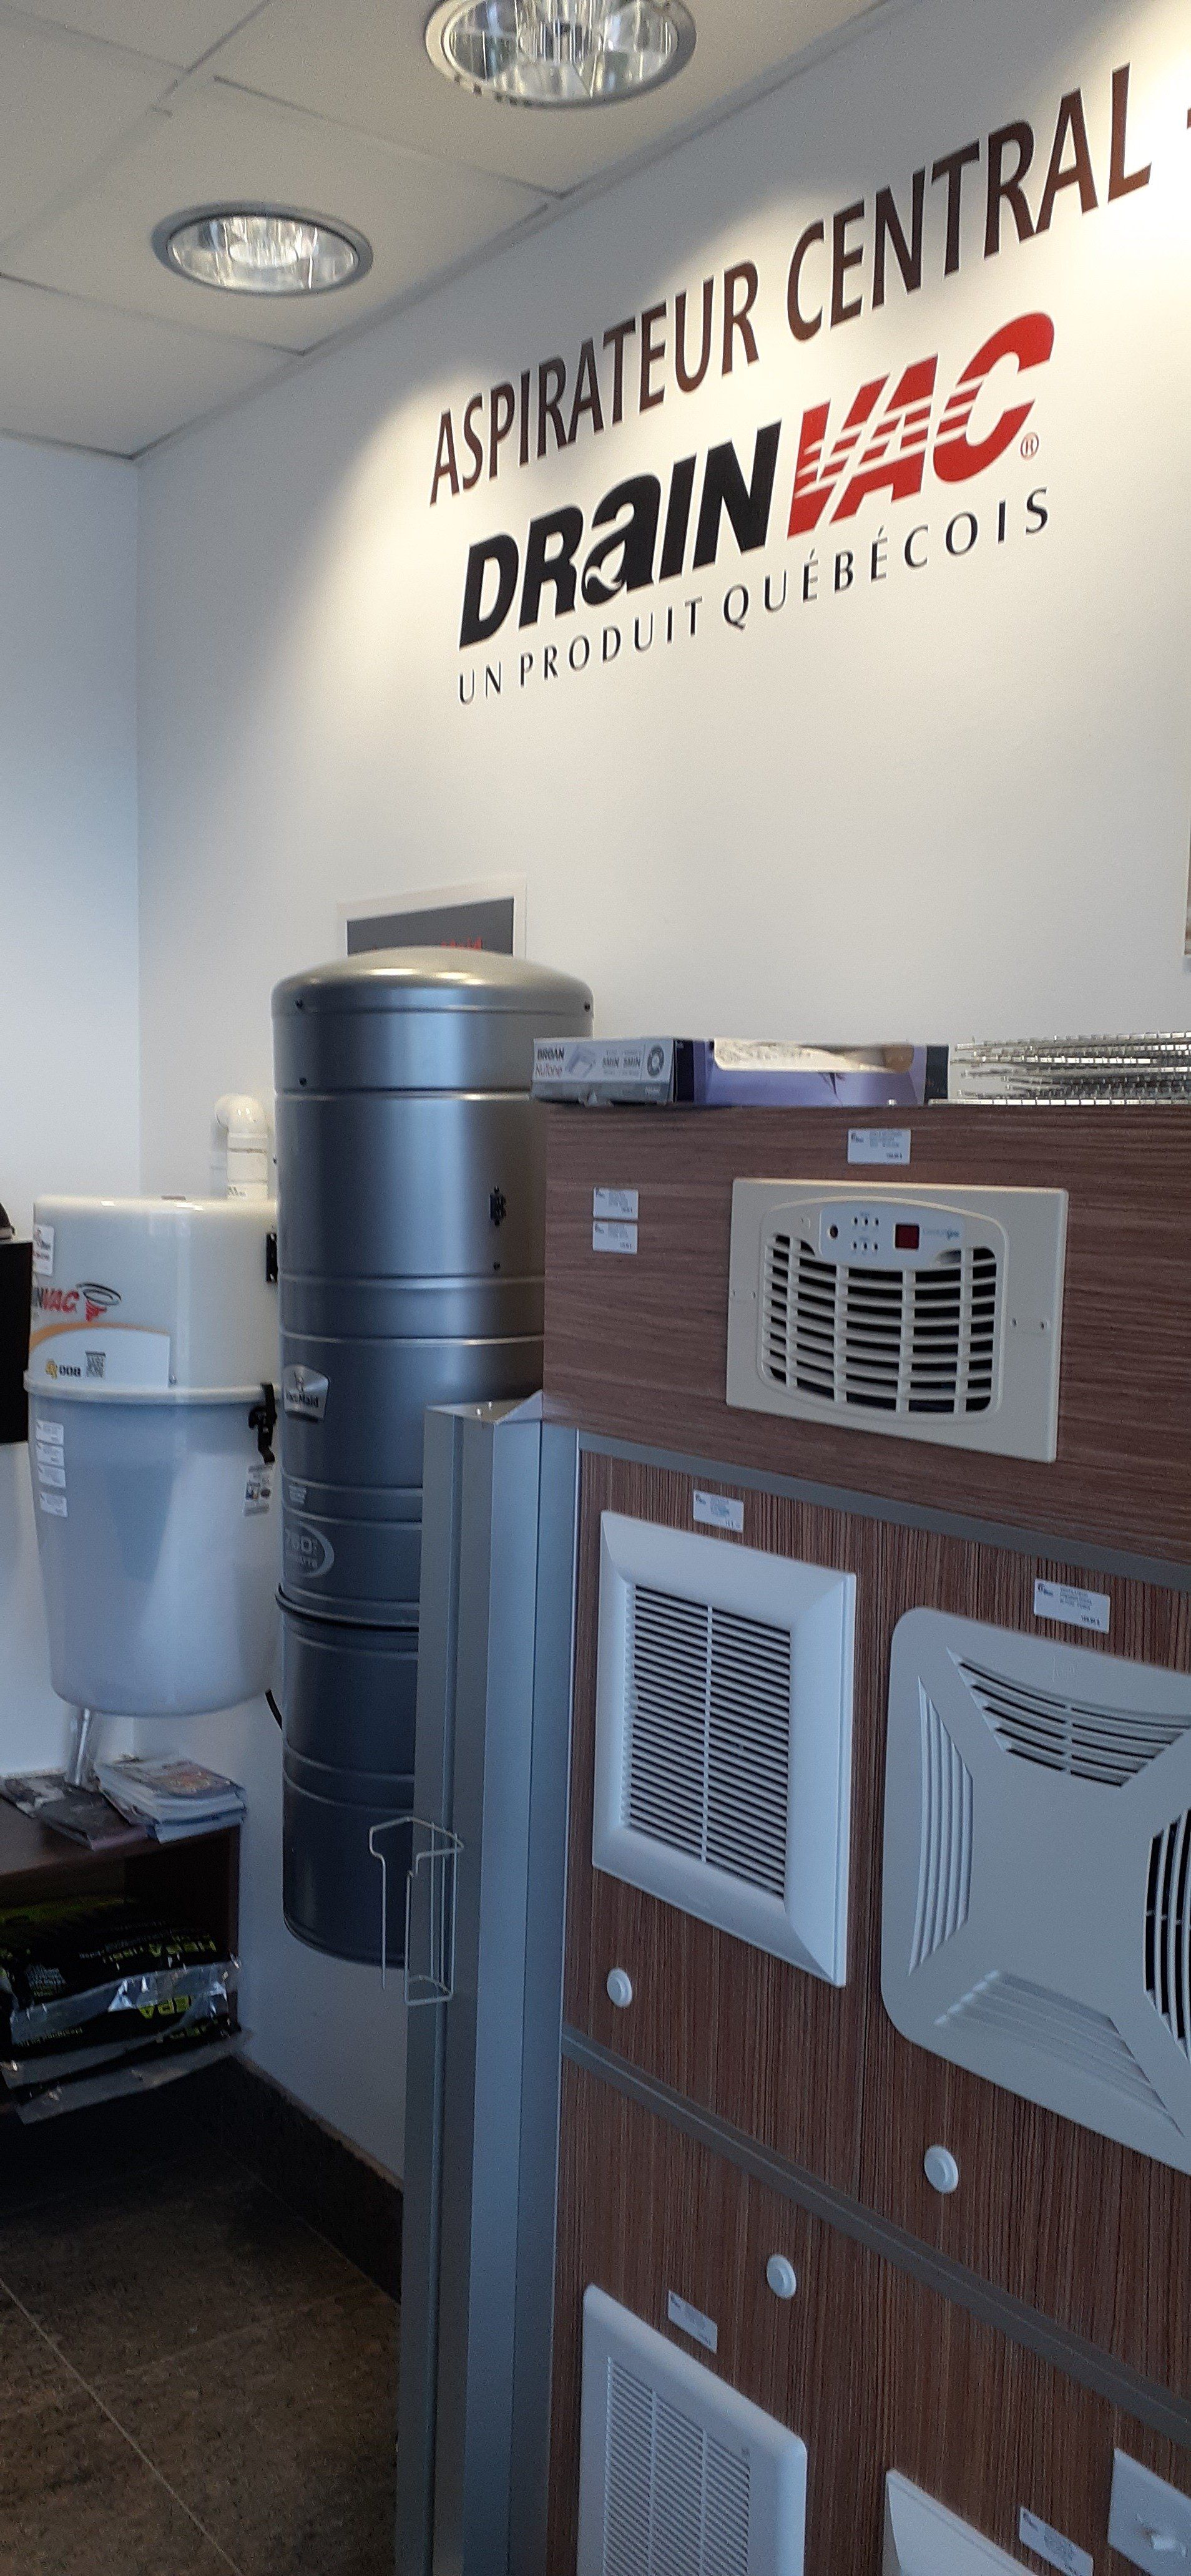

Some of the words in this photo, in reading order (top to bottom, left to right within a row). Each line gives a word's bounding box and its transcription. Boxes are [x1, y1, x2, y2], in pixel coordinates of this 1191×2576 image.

[429, 261, 760, 505] ASPIRATEUR
[787, 64, 1152, 341] CENTRAL
[458, 663, 502, 705] UN
[519, 596, 705, 688] PRODUIT
[722, 486, 1049, 630] QUÉBÉCOIS
